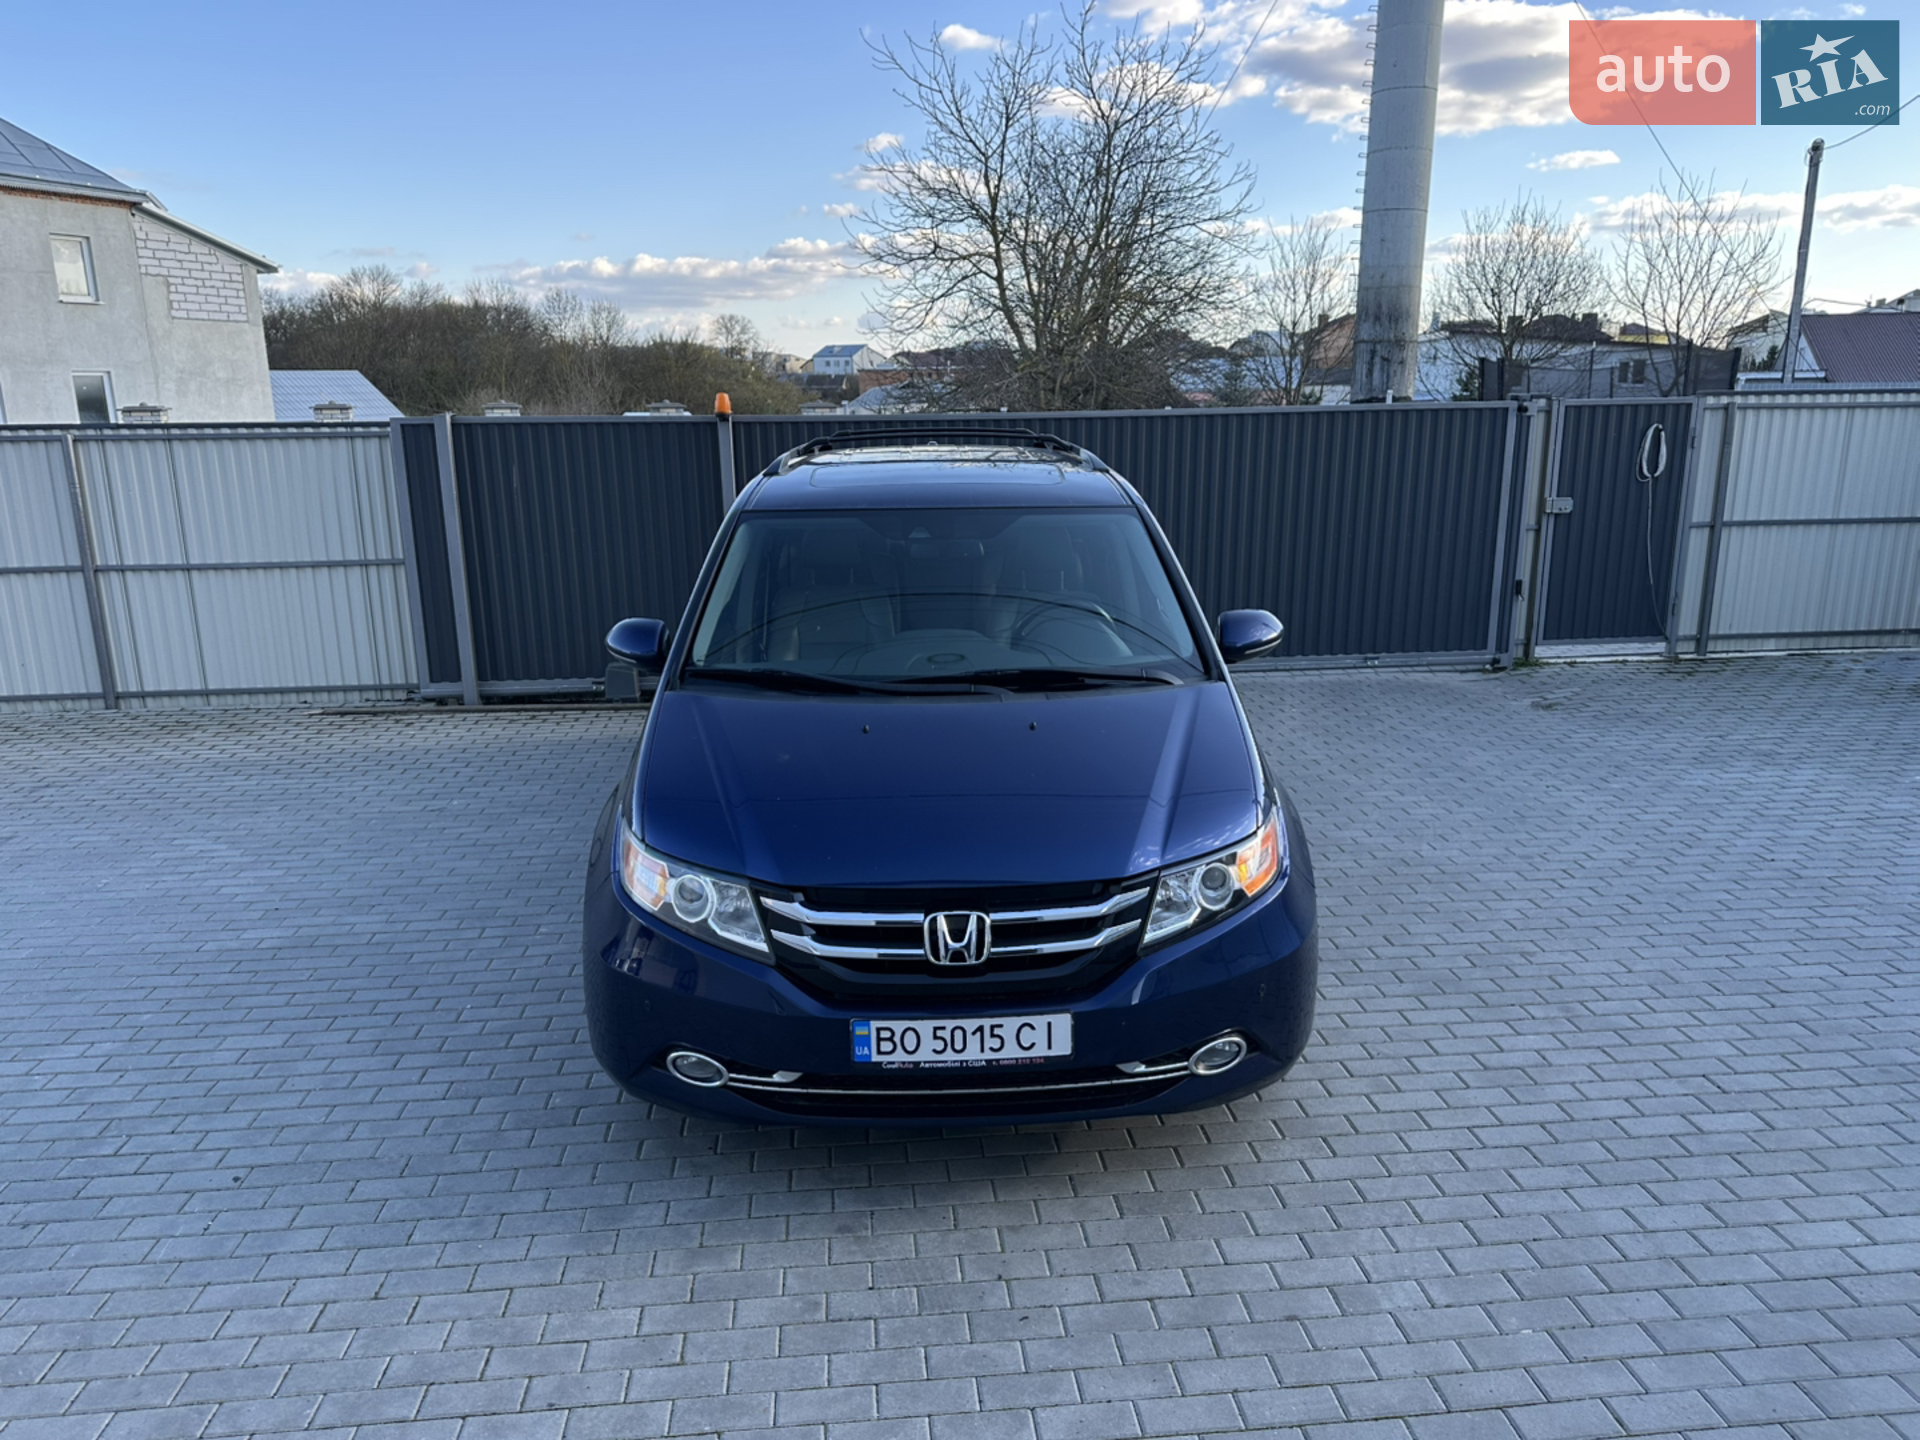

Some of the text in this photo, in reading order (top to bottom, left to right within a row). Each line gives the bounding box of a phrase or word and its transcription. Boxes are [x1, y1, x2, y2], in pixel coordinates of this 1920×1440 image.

[875, 1021, 1053, 1056] BO 5015 CI
[855, 1046, 870, 1056] UA
